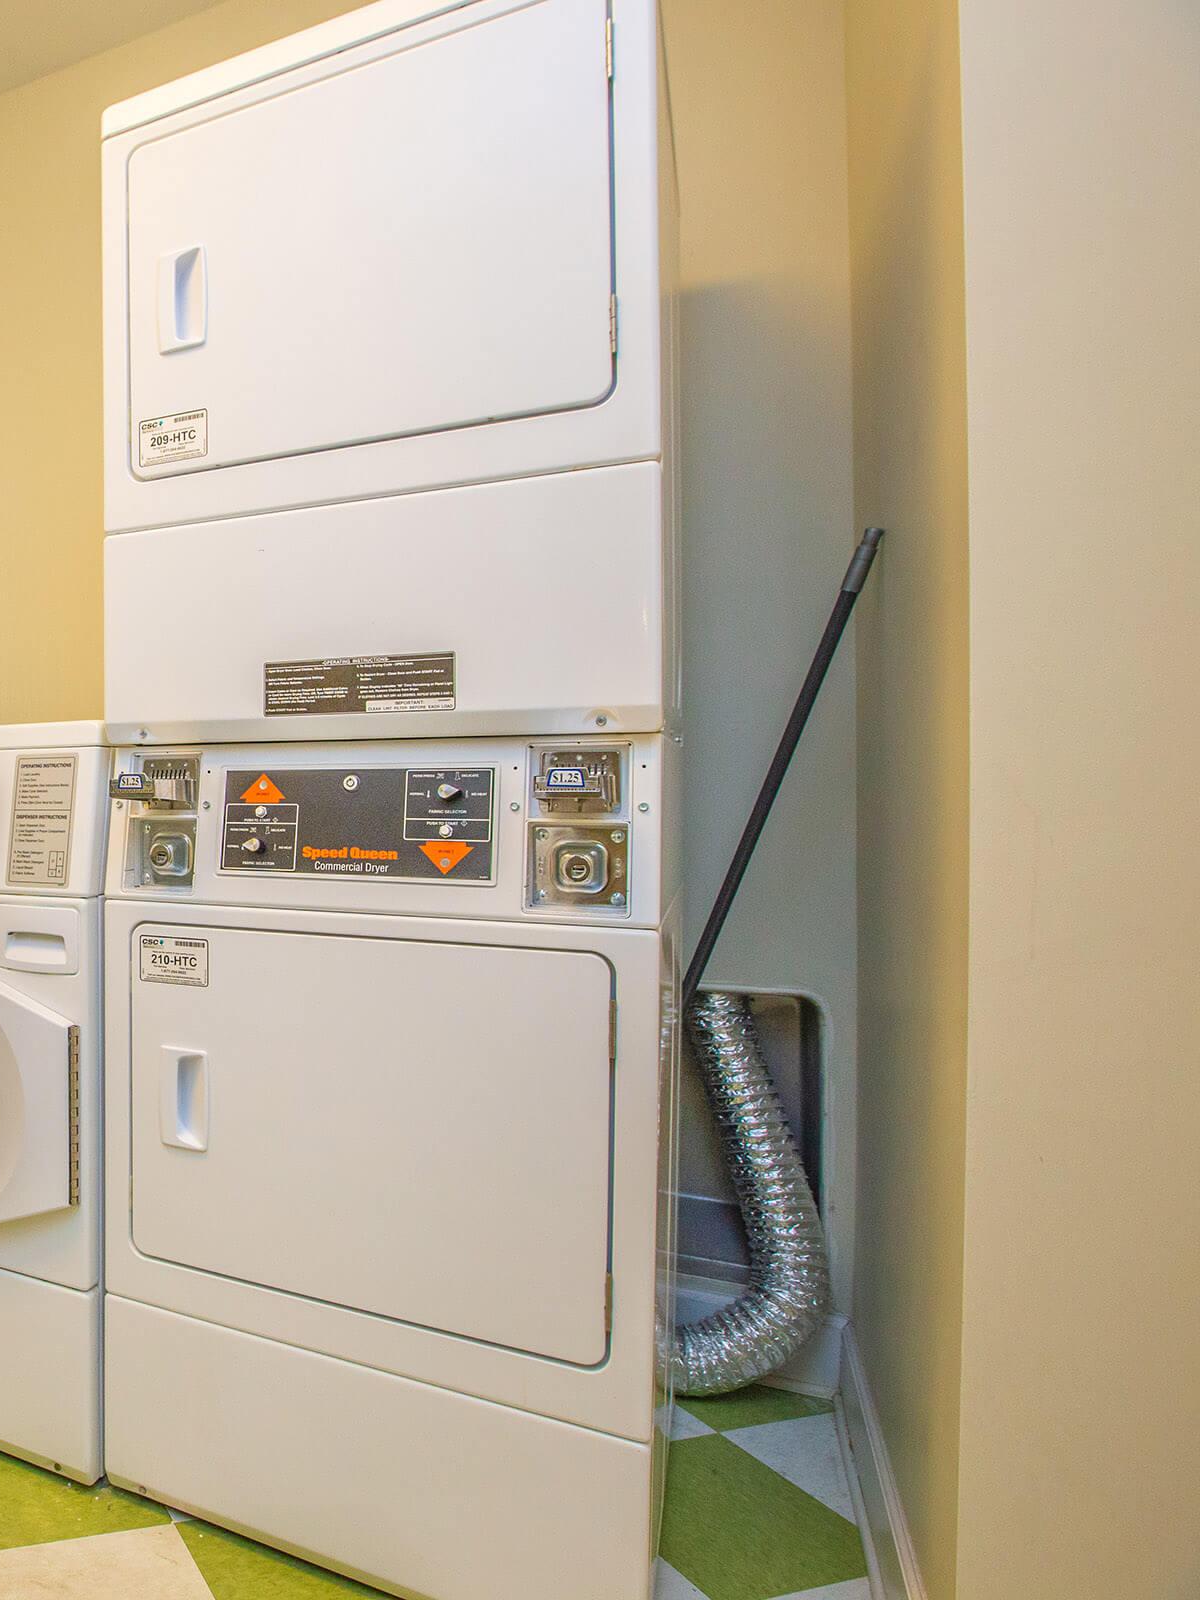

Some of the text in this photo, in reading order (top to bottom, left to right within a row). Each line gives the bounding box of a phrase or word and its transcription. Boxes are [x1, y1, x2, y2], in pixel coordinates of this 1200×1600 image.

[150, 429, 197, 447] 209-HTC
[121, 776, 140, 786] $1.25
[552, 773, 579, 783] $1.25
[302, 846, 398, 860] Speed Queen
[314, 861, 389, 874] Commercial Dryer
[151, 954, 197, 967] 210-HTC
